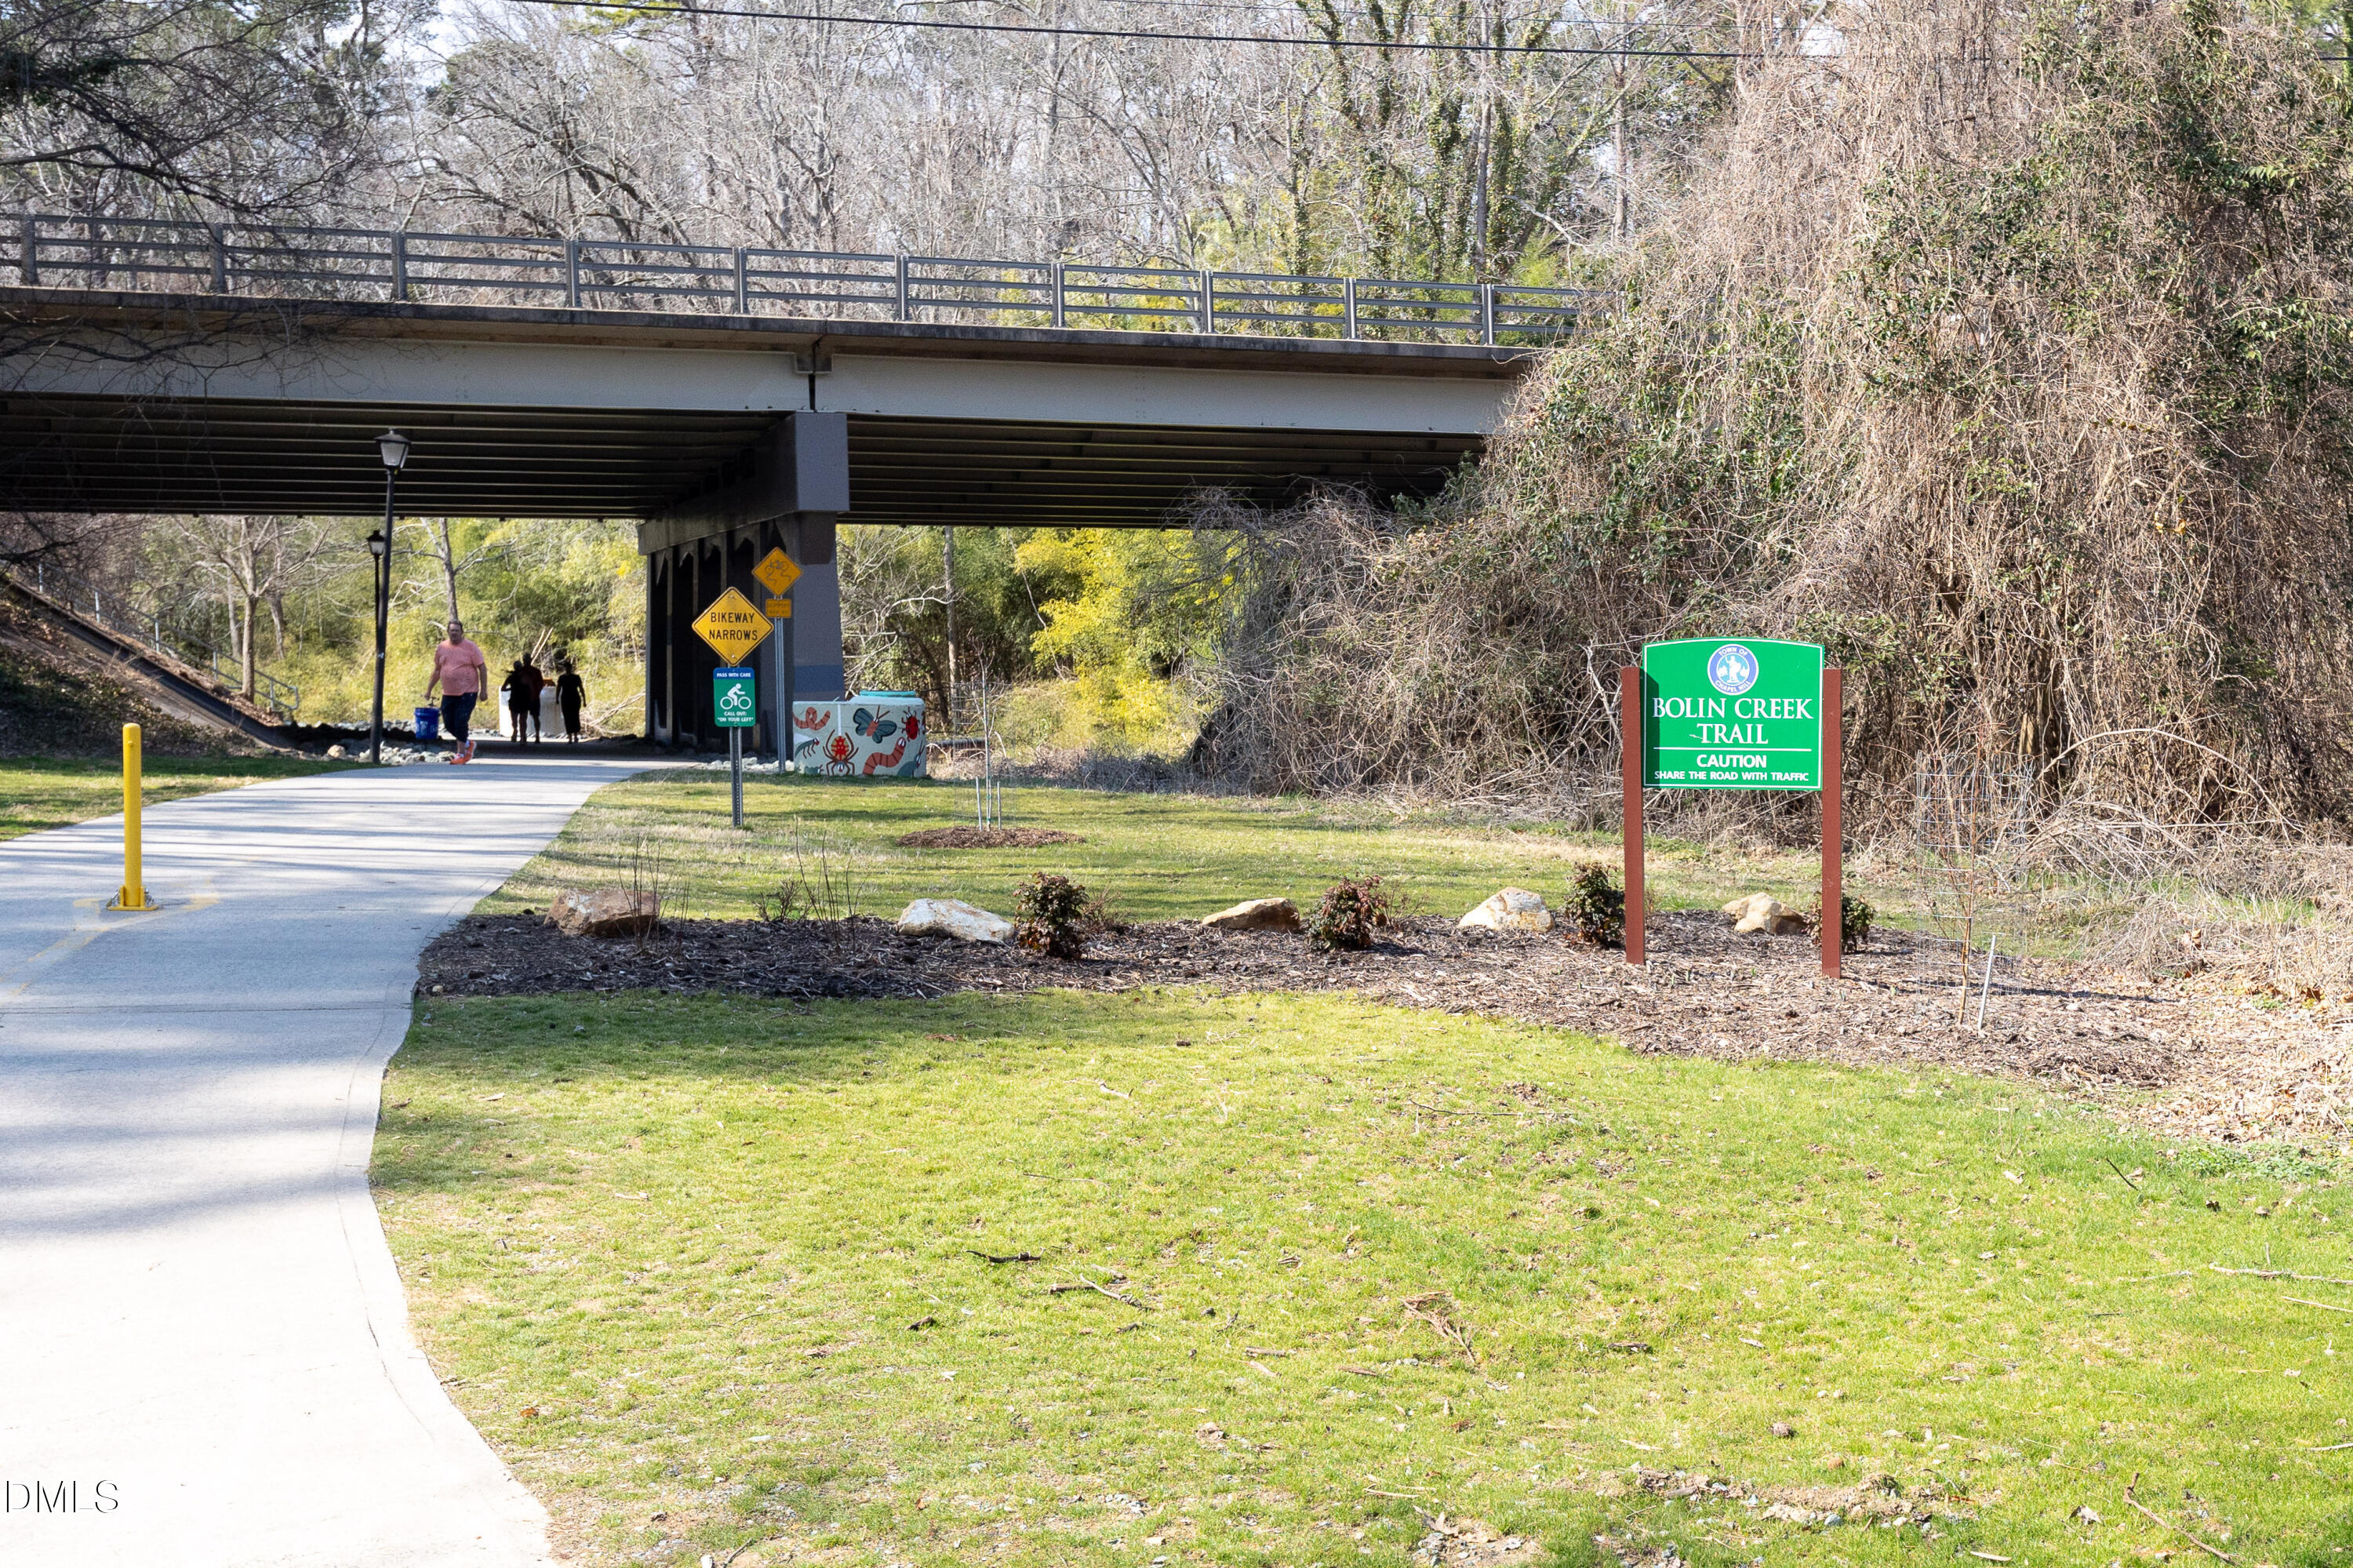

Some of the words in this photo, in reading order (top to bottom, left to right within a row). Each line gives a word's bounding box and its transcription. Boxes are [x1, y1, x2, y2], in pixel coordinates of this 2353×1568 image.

[711, 612, 755, 623] BIKEWAY
[709, 629, 758, 641] NARROWS
[1718, 647, 1737, 656] TOWN
[1715, 680, 1737, 692] CHAPEL
[1652, 697, 1726, 719] BOLIN
[1734, 698, 1813, 719] CREEK
[1697, 723, 1769, 744] TRAIL
[1697, 755, 1767, 768] CAUTION
[1654, 771, 1685, 780] SHARE
[1689, 771, 1707, 780] THE
[1710, 771, 1738, 780] ROAD
[1741, 772, 1768, 780] WITH
[1771, 772, 1809, 781] TRAFFIC
